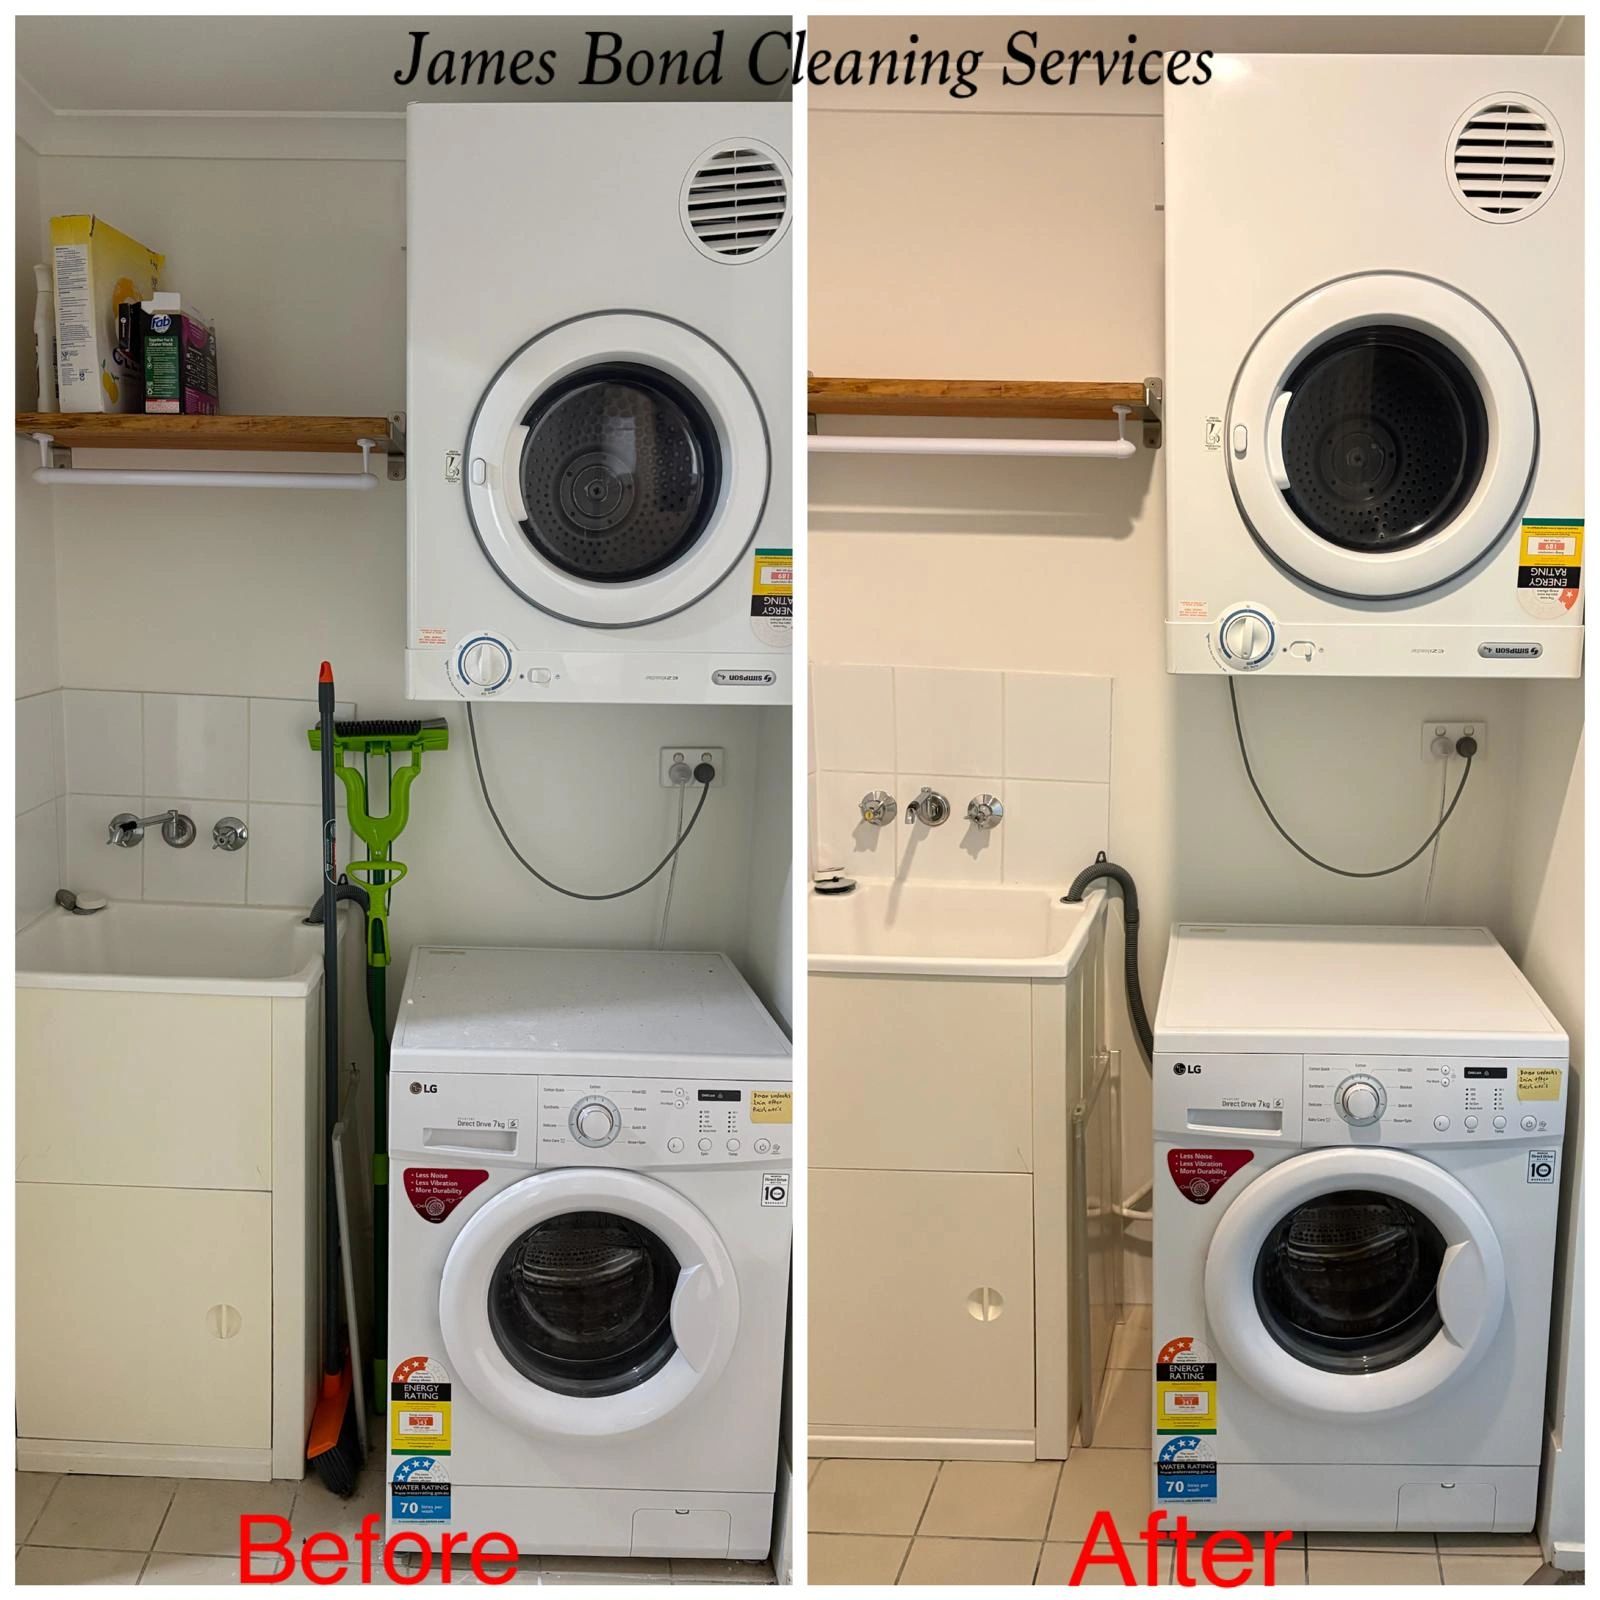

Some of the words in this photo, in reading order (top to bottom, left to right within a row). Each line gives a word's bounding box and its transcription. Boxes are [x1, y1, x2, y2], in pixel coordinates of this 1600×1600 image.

[152, 316, 170, 329] Fab
[1530, 568, 1566, 576] RATING
[1529, 577, 1567, 586] ENERGY
[764, 597, 792, 605] ATING
[762, 606, 792, 615] NERGY
[1187, 1065, 1201, 1074] LG
[424, 1084, 438, 1093] LG
[1531, 1163, 1551, 1177] 10
[765, 1187, 785, 1200] 10
[1166, 1481, 1184, 1492] 70
[400, 1502, 418, 1513] 70
